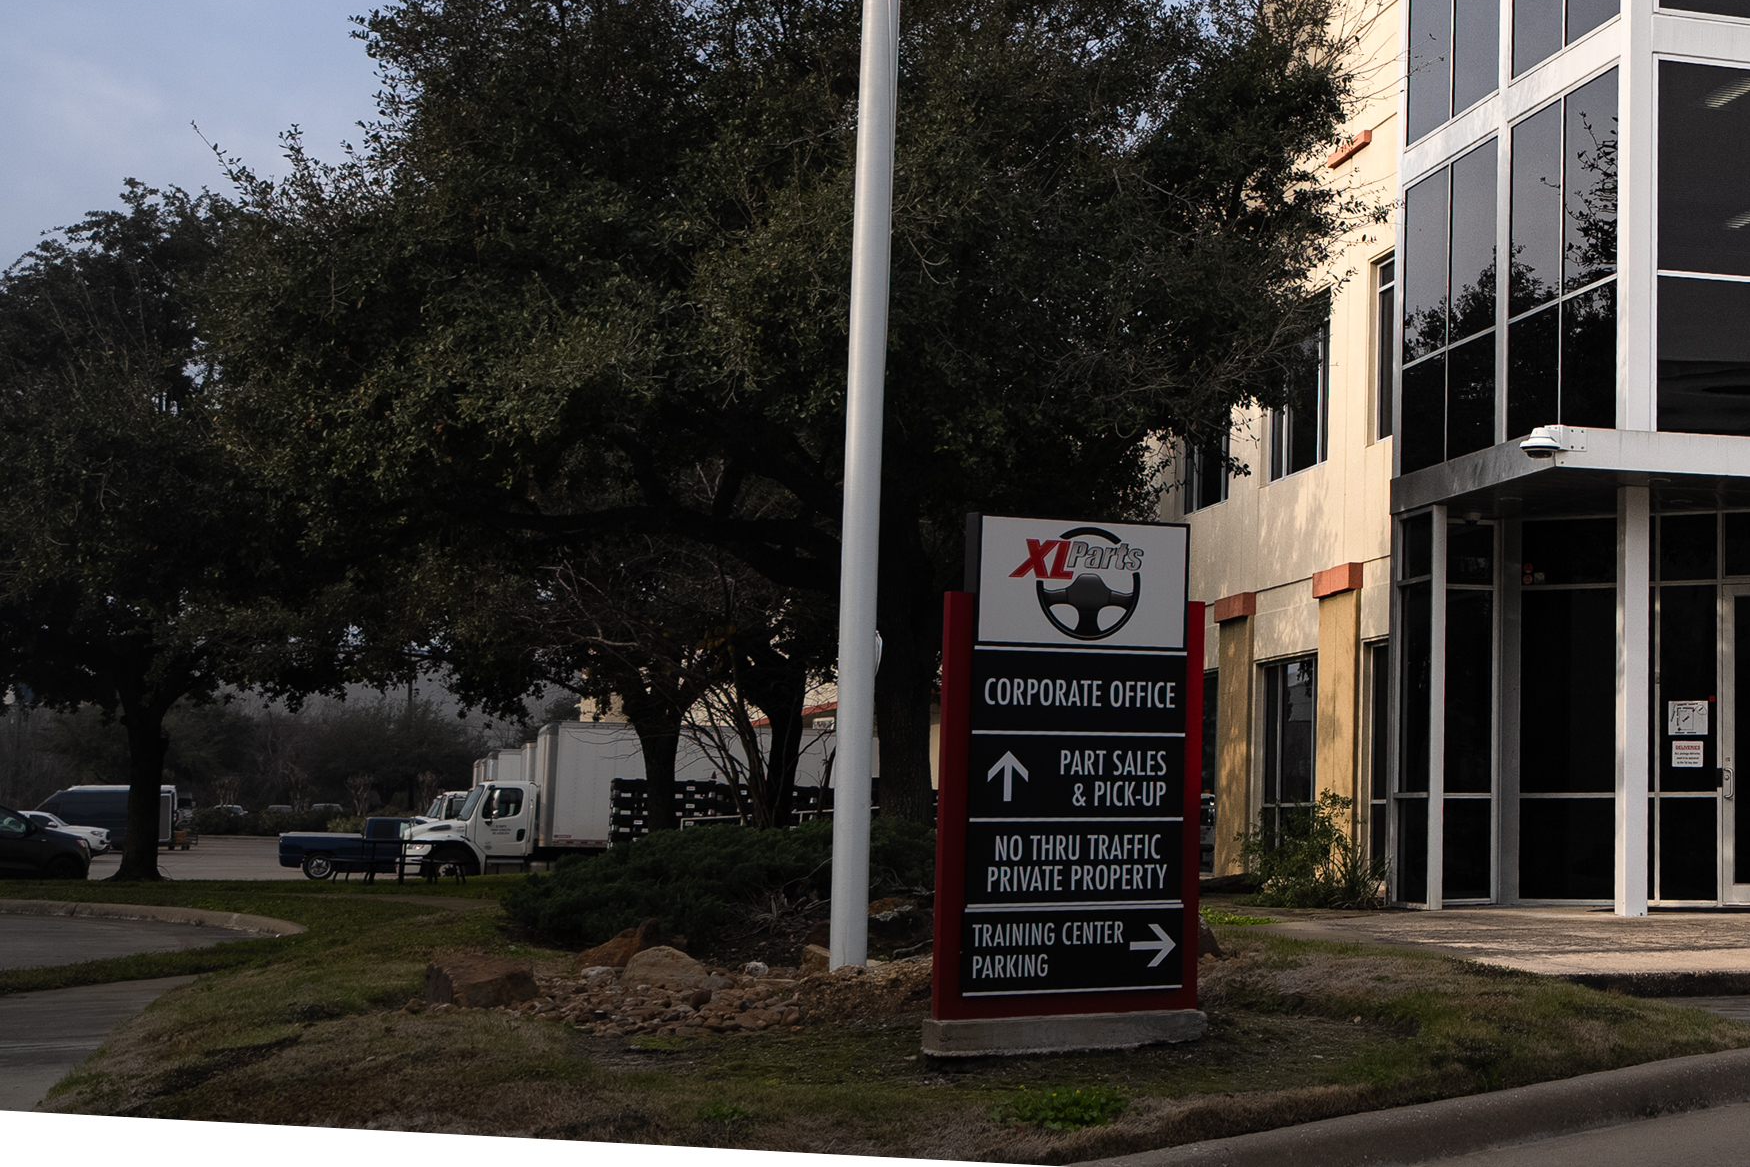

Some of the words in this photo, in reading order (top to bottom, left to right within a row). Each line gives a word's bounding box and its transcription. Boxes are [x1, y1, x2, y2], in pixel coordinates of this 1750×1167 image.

[984, 677, 1103, 707] CORPORATE
[1109, 680, 1176, 709] OFFICE
[1059, 749, 1107, 775] PART
[1113, 750, 1167, 776] SALES
[1072, 783, 1087, 807] &
[1094, 781, 1167, 807] PICK-UP
[994, 835, 1023, 861] NO
[1030, 834, 1081, 861] THRU
[1087, 834, 1161, 860] TRAFFIC
[987, 865, 1063, 892] PRIVATE
[1070, 864, 1168, 891] PROPERTY
[972, 922, 1055, 947] TRAINING
[1062, 921, 1124, 945] CENTER
[972, 954, 1049, 979] PARKING
